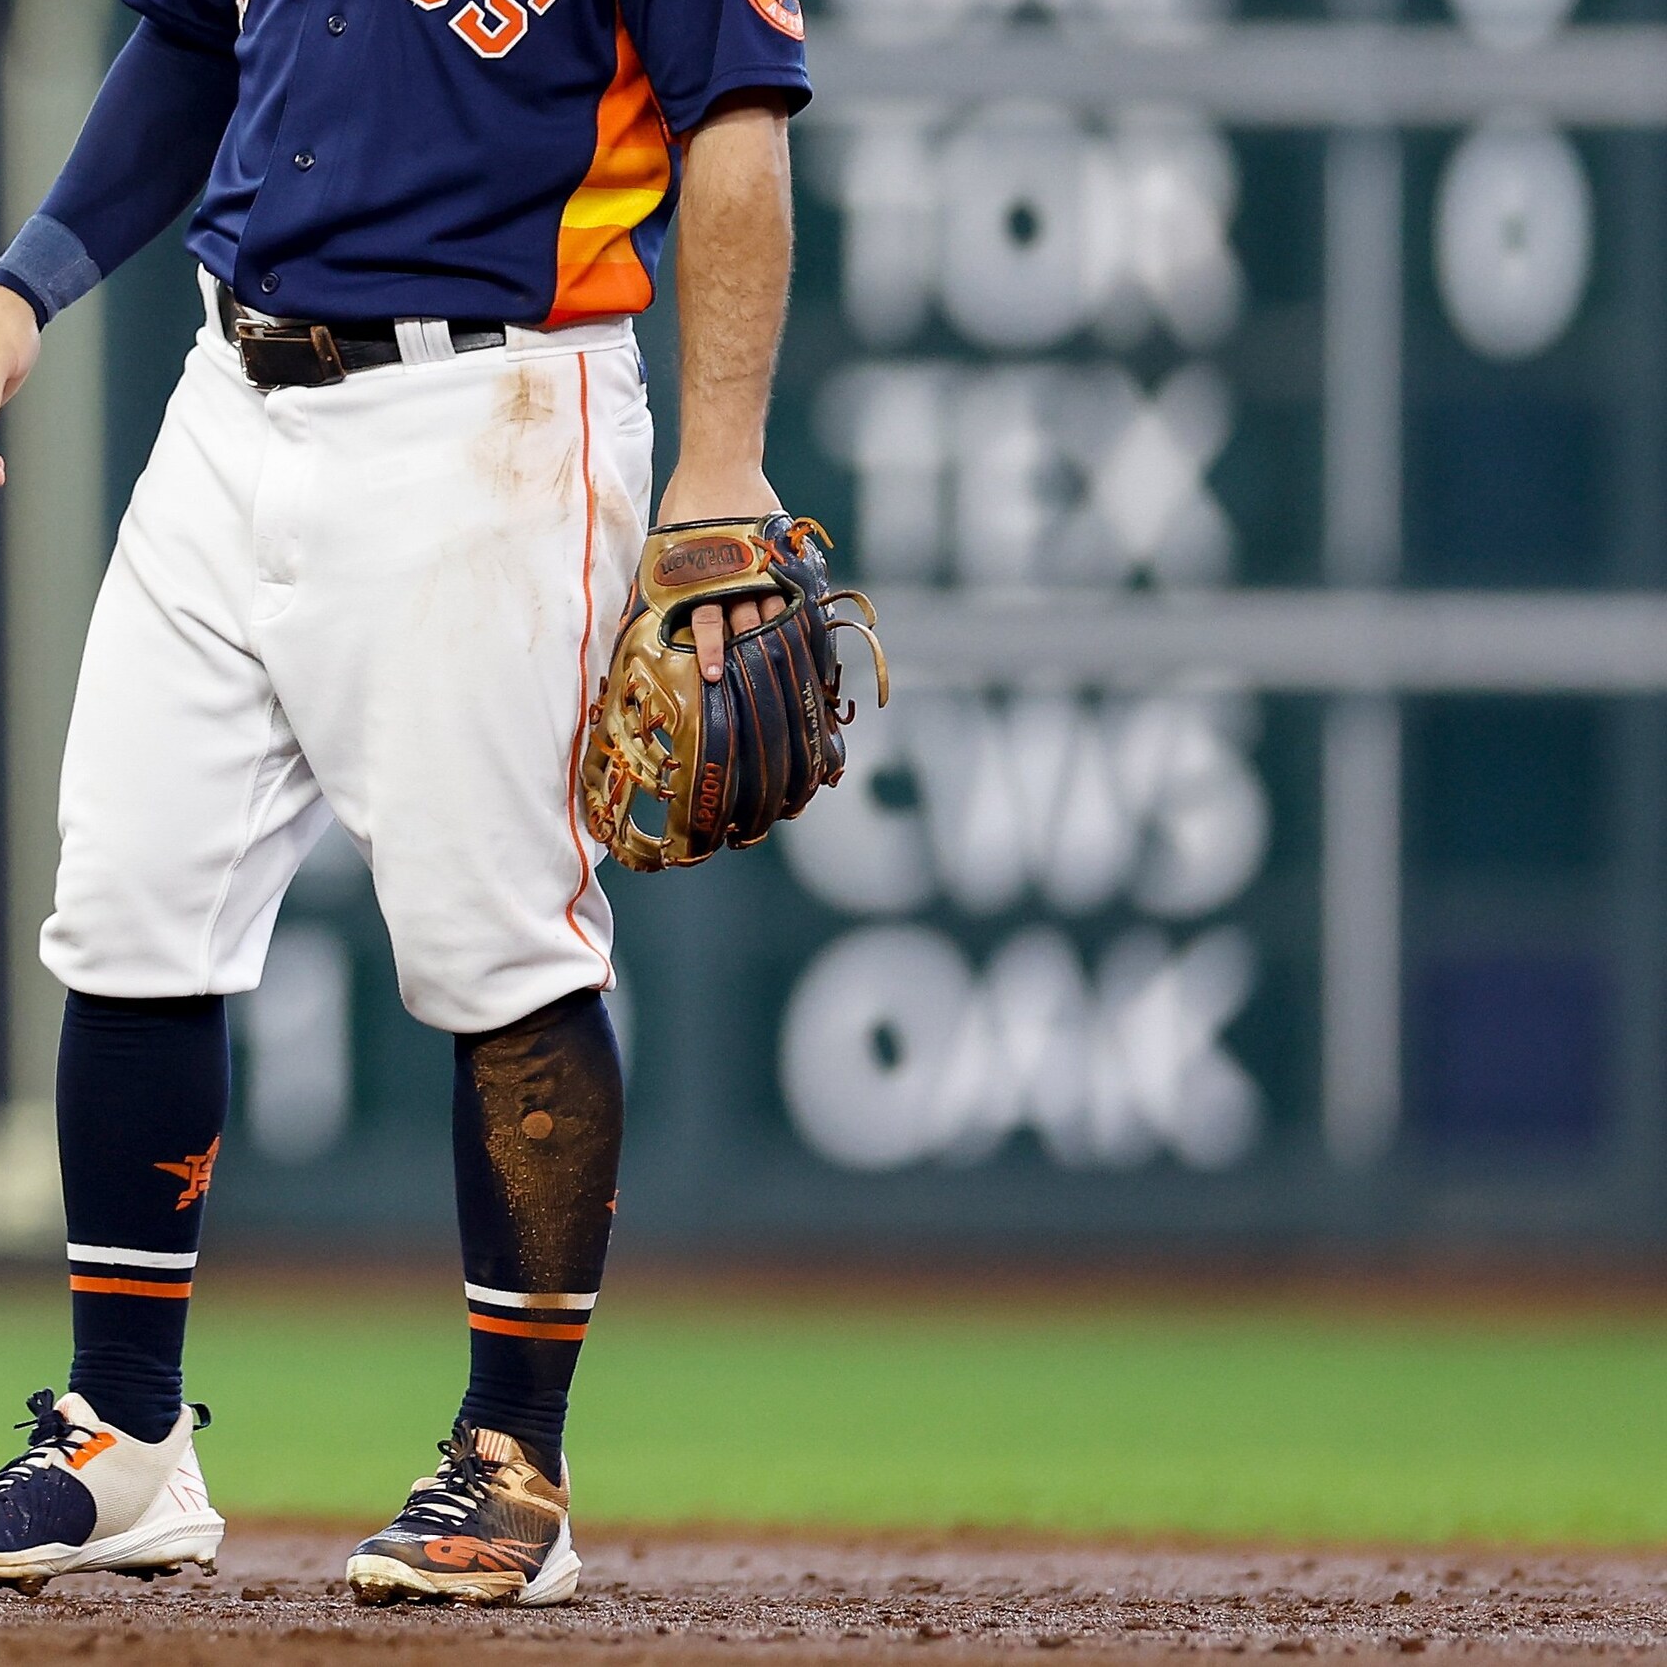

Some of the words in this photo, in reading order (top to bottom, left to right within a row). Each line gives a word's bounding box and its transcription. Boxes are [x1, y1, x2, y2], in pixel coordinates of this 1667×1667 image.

[1437, 109, 1592, 356] 0
[817, 359, 1239, 584] TEX
[779, 926, 1265, 1172] OAK
